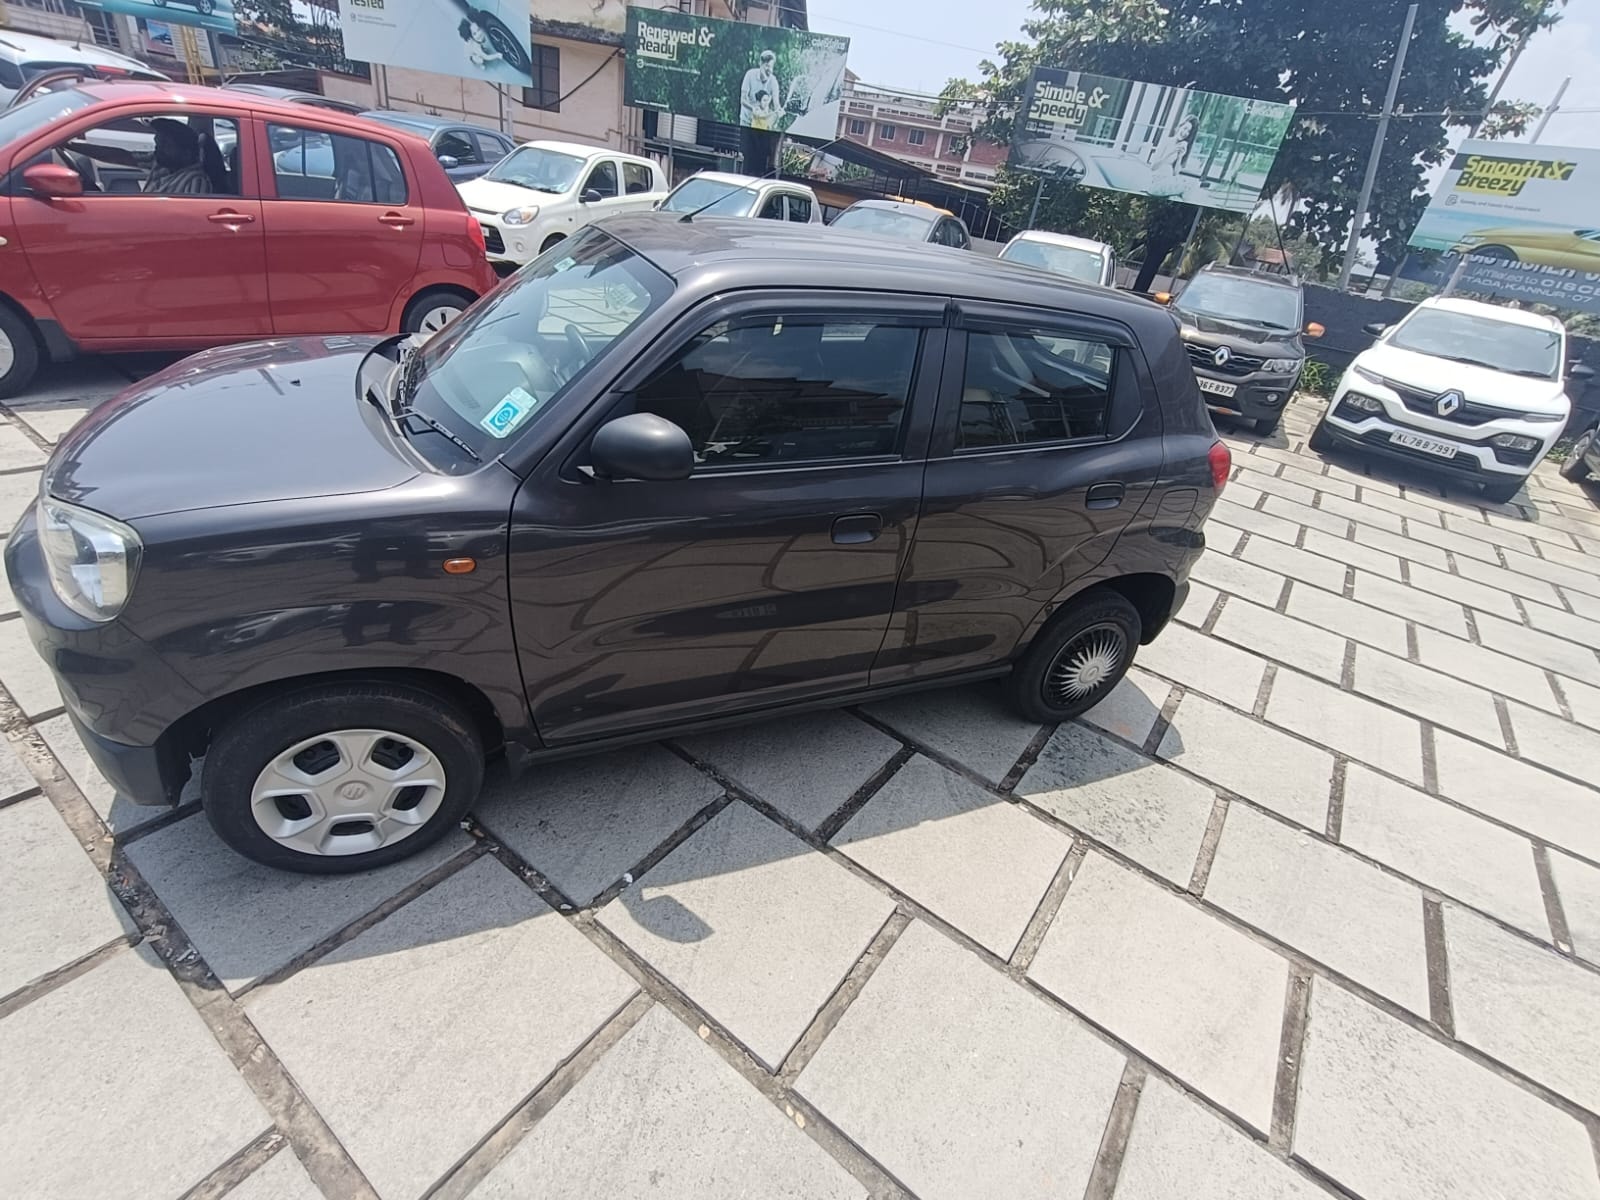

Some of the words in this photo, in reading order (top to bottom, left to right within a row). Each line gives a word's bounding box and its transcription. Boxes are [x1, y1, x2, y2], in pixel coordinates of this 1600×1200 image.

[637, 21, 696, 45] Renewed
[698, 27, 715, 47] &
[639, 37, 676, 59] Ready
[1034, 81, 1086, 104] Simple
[1087, 86, 1111, 109] &
[1030, 100, 1086, 124] Speedy
[1463, 155, 1544, 178] Smooth
[1544, 160, 1577, 180] &
[1456, 171, 1527, 196] Breezy
